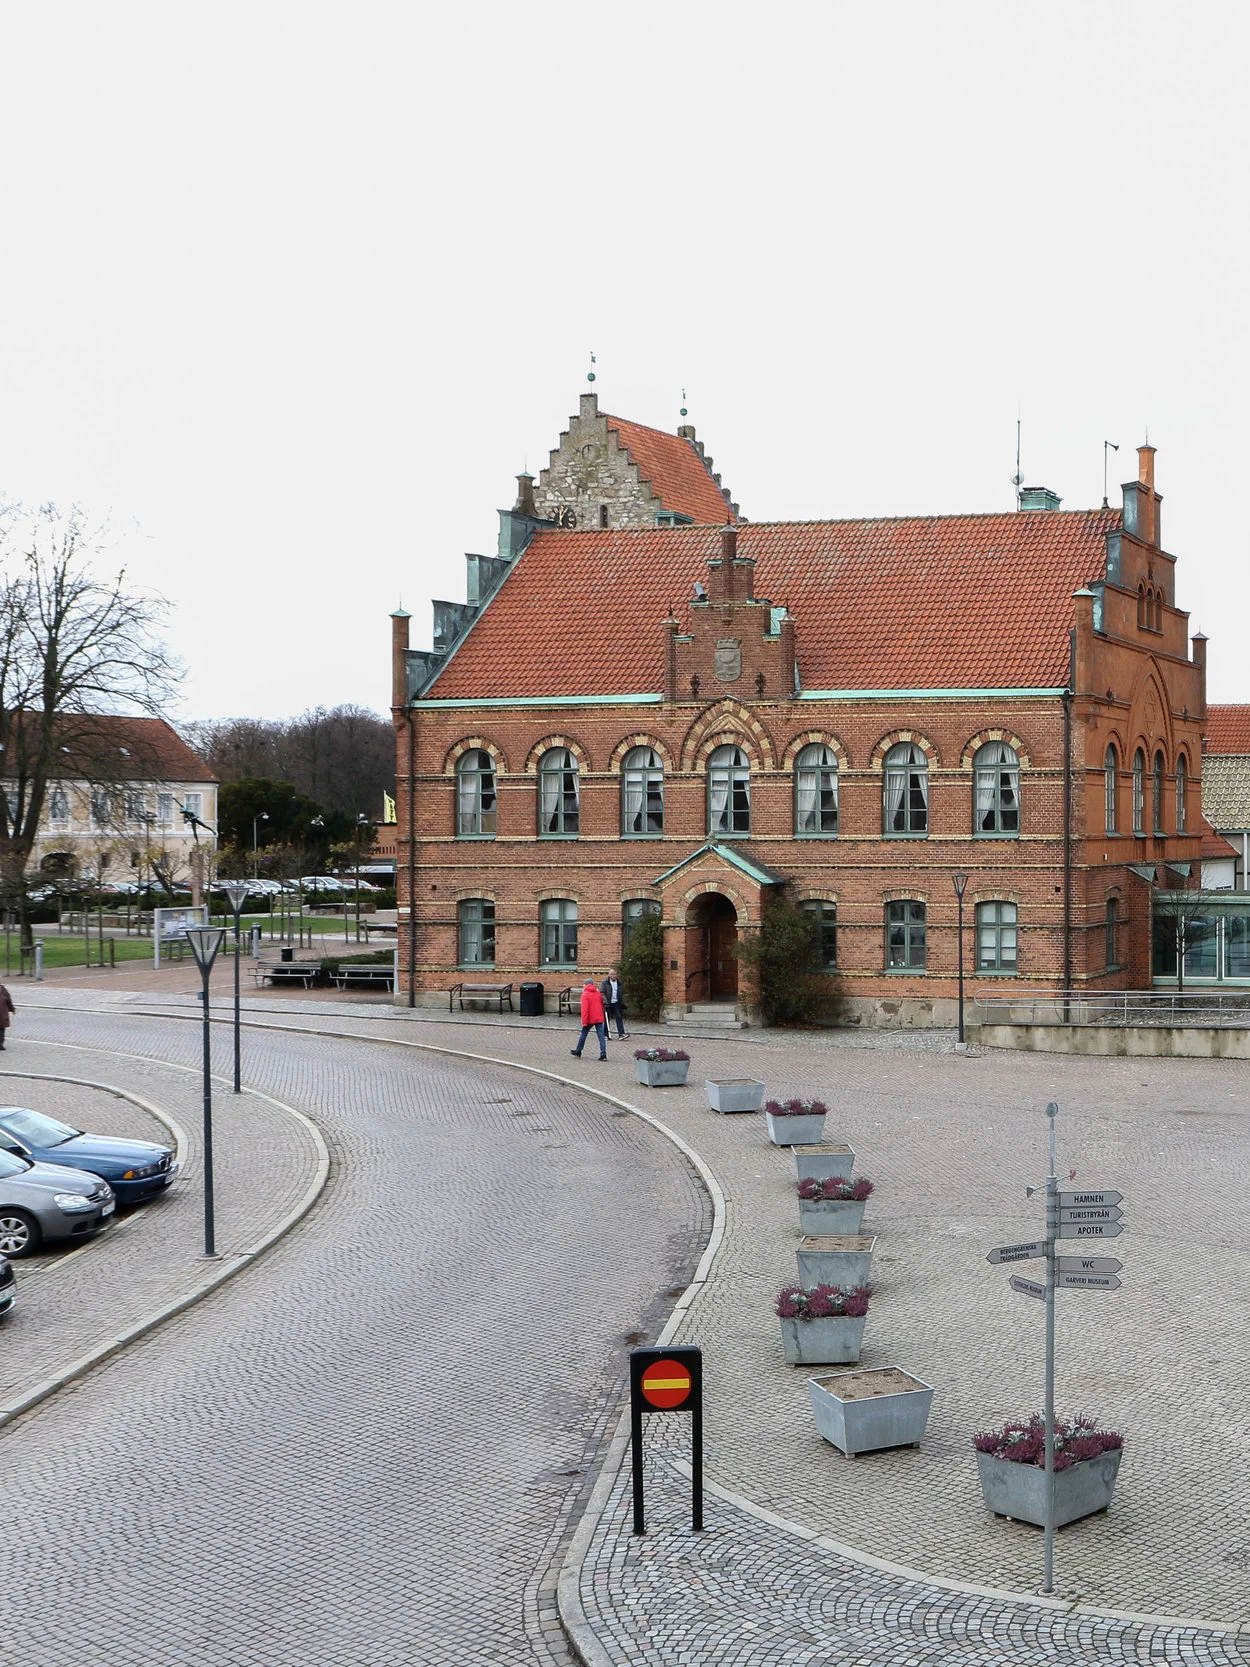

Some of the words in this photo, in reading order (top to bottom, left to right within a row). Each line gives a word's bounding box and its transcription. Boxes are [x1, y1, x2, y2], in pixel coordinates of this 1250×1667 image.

[1074, 1195, 1104, 1203] HAMNEN
[1070, 1209, 1110, 1218] TURISTBYRÅN
[1077, 1226, 1104, 1235] APOTEK
[1082, 1260, 1095, 1268] WC
